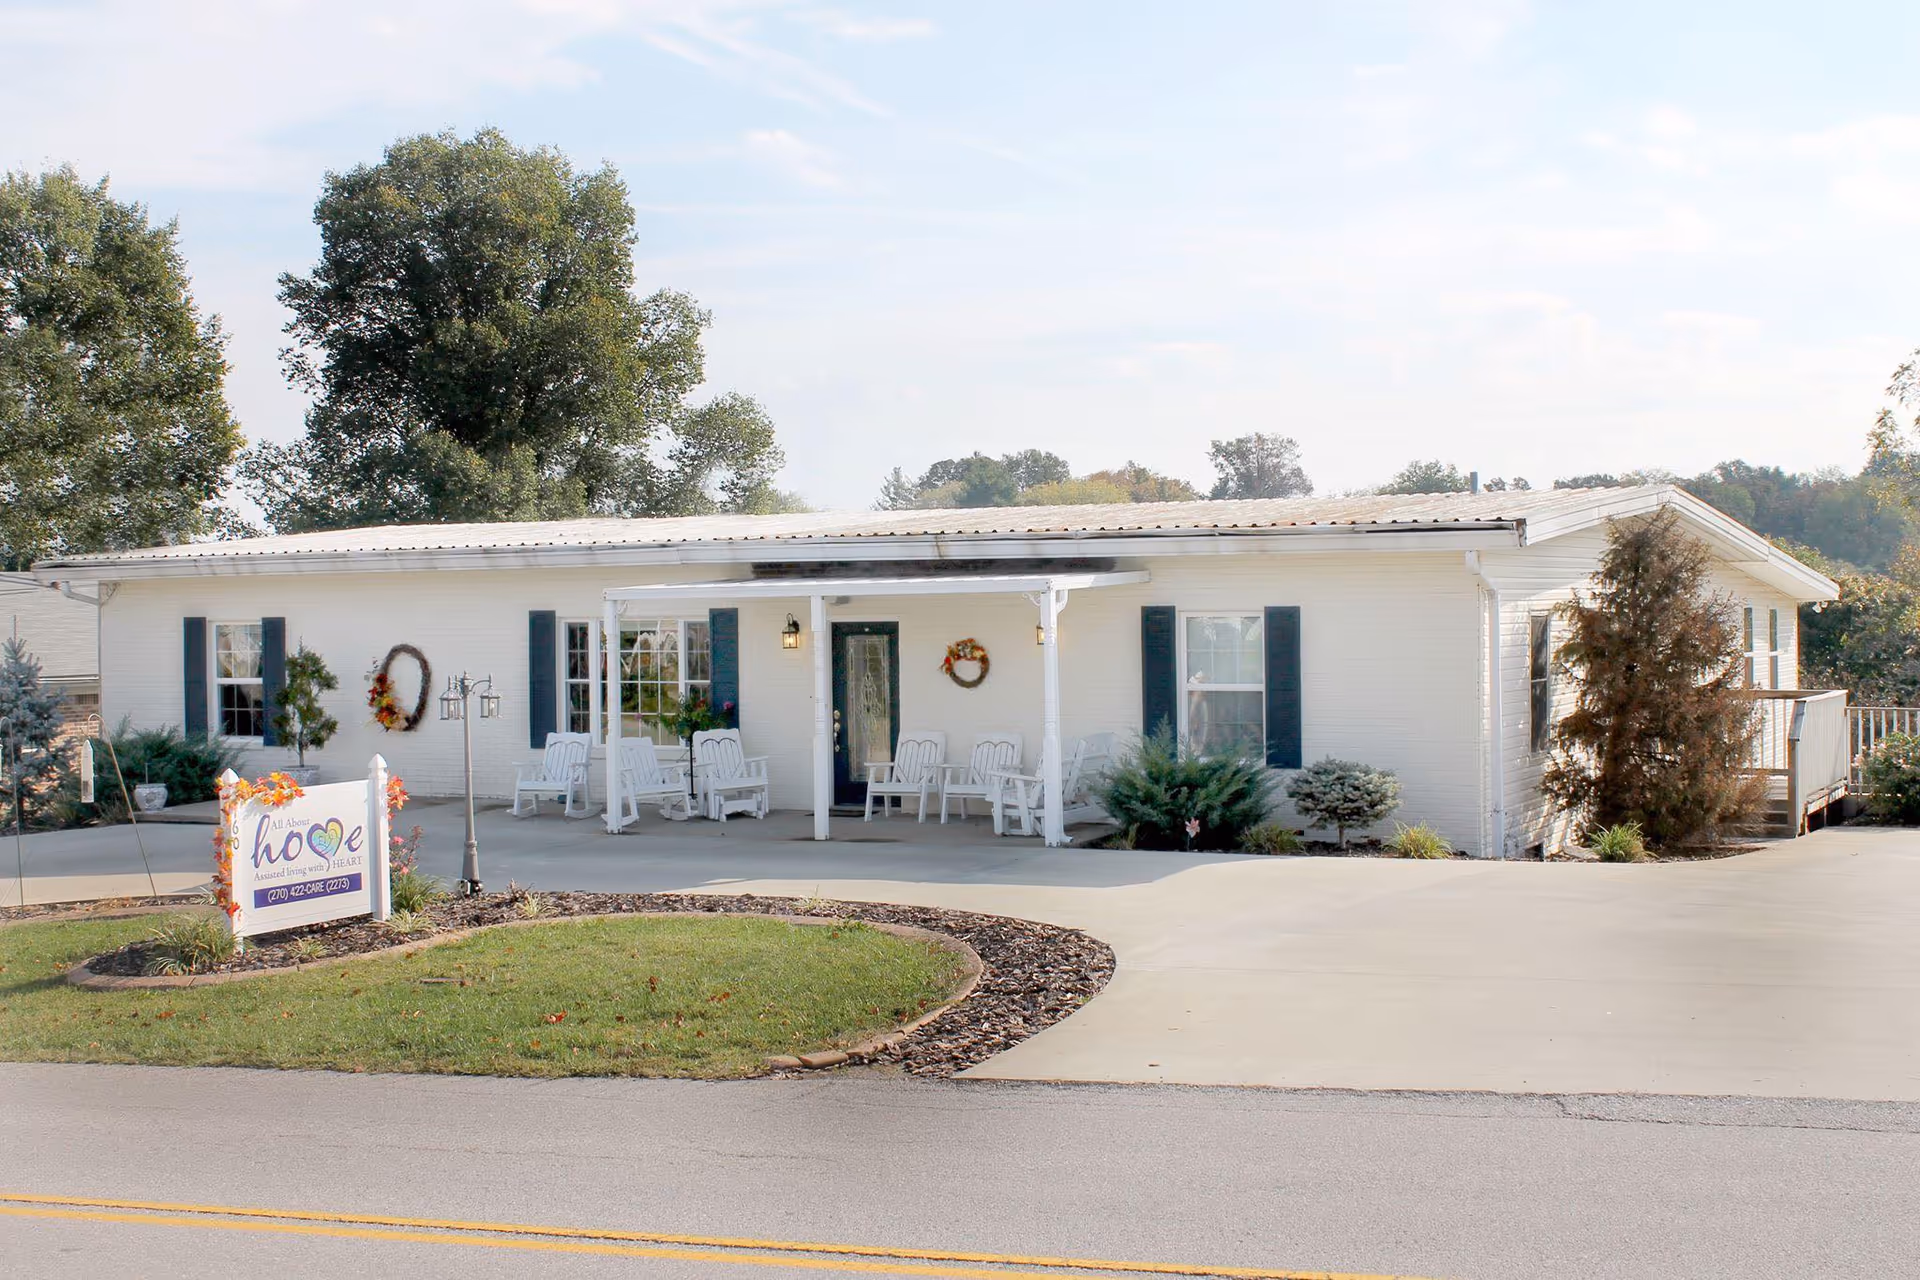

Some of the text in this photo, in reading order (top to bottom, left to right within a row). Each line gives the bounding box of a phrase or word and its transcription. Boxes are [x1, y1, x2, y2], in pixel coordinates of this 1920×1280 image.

[271, 818, 310, 830] All About
[254, 856, 363, 881] Assisted living with HEART
[267, 877, 350, 903] (270) 422-CARE (2273)
